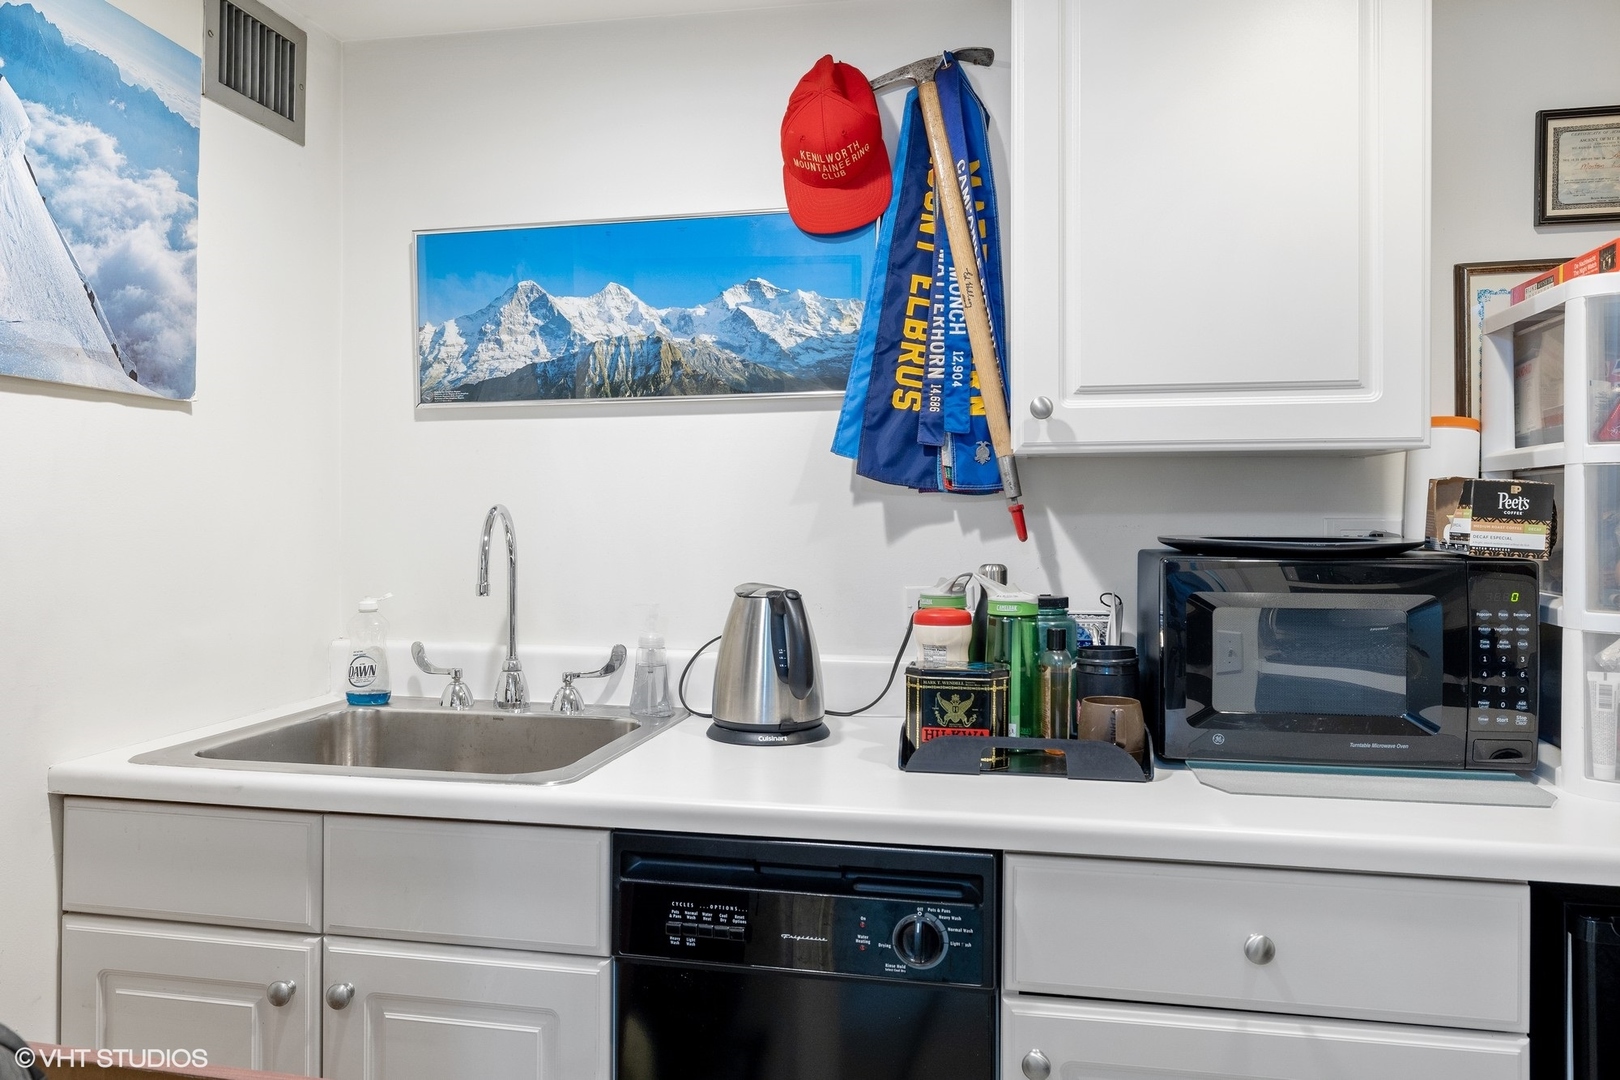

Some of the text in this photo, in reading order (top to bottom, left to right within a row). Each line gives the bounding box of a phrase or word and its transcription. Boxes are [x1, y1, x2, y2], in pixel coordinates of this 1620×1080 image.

[800, 140, 860, 163] KENILWORTH
[822, 170, 846, 180] CLUB
[892, 274, 932, 412] ELBRUS
[952, 351, 964, 387] 12,904
[929, 384, 942, 412] 14,686
[1498, 492, 1530, 510] Peet's
[349, 664, 376, 677] DAWN
